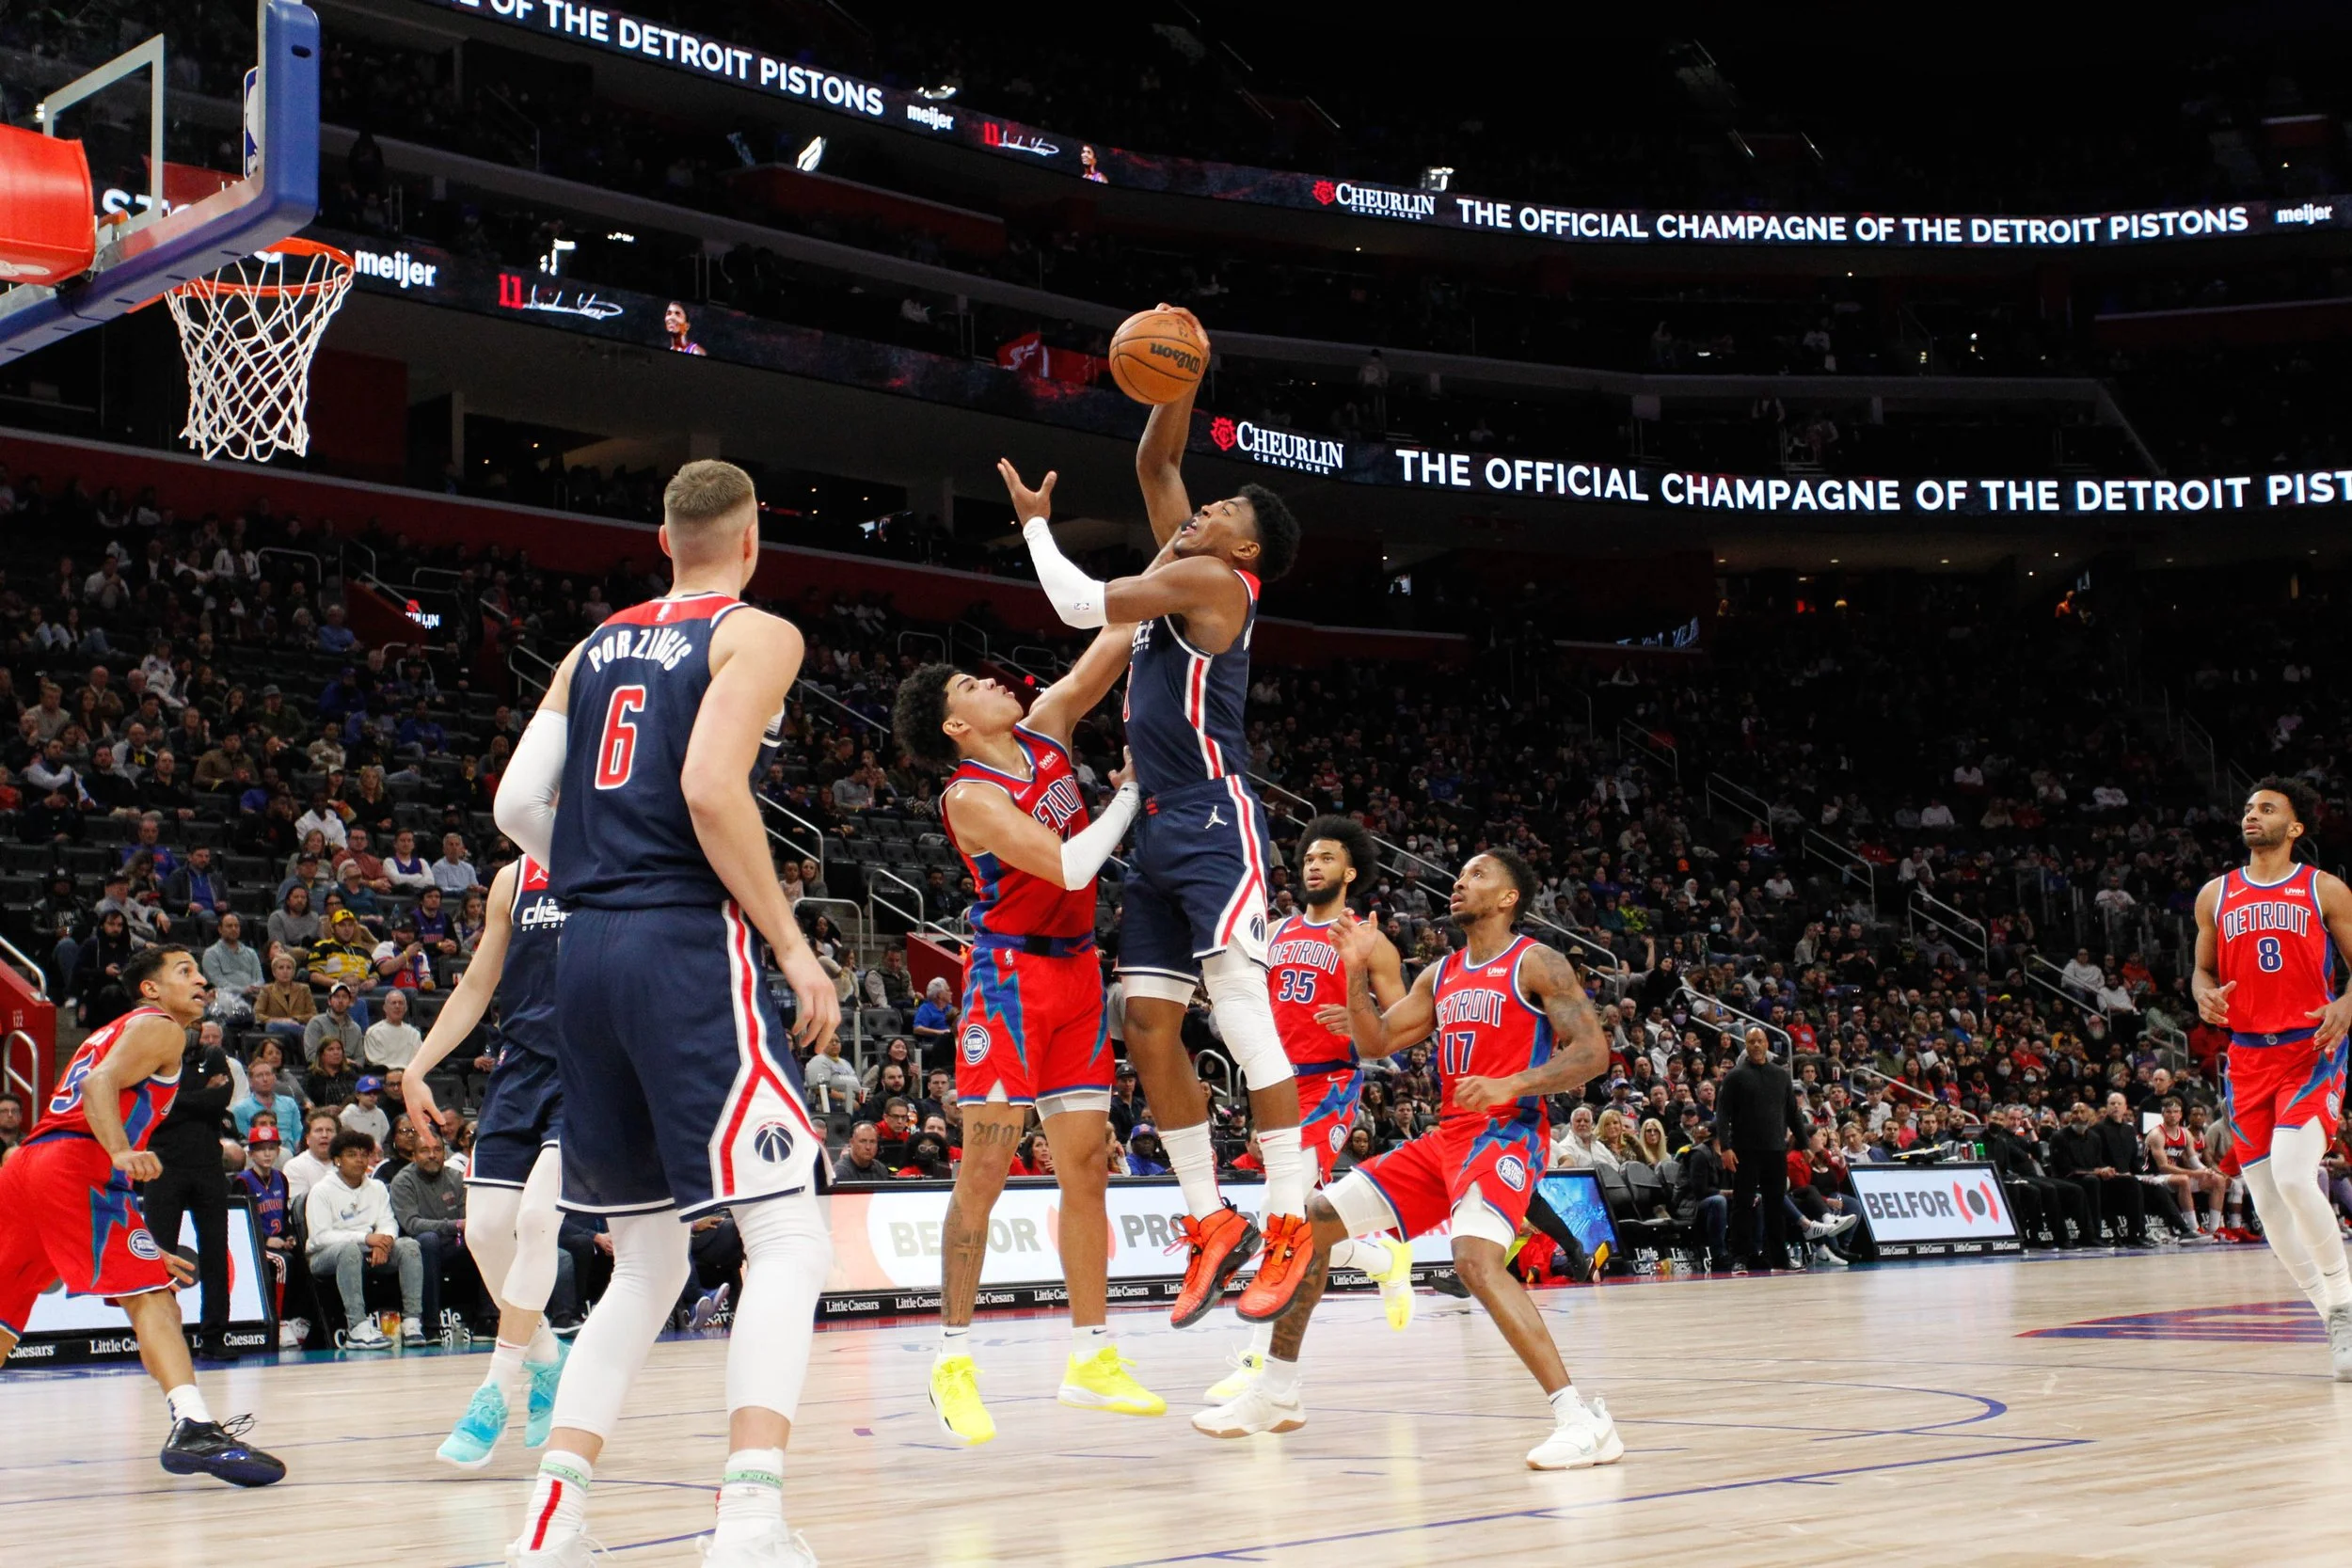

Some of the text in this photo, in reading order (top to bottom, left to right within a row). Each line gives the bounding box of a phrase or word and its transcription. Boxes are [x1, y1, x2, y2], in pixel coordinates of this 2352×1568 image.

[543, 0, 610, 42] THE
[619, 18, 752, 79] DETROIT
[760, 56, 884, 116] PISTONS
[906, 103, 954, 130] meijer
[1335, 182, 1436, 215] CHEURLIN
[2275, 203, 2333, 225] meijer
[1456, 198, 2249, 244] THE OFFICIAL CHAMPAGNE OF THE DETROIT PISTONS
[355, 248, 437, 289] meijer
[499, 273, 524, 309] 11
[1236, 421, 1343, 469] CHEURLIN
[1253, 452, 1329, 475] CHAMPAGNE
[1395, 449, 2352, 511] THE OFFICIAL CHAMPAGNE OF THE DETROIT PIST
[587, 626, 692, 673] PORZINGIS
[594, 684, 646, 790] 6
[2223, 901, 2311, 942] DETROIT
[2258, 936, 2282, 973] 8
[1278, 969, 1317, 1004] 35
[1445, 1031, 1475, 1074] 17
[49, 1048, 92, 1114] 5
[1864, 1190, 1955, 1220] BELFOR
[889, 1217, 1042, 1259] BEOR
[1034, 1290, 1054, 1301] Little
[1121, 1286, 1149, 1296] Caesars
[1333, 1275, 1349, 1285] Little
[826, 1299, 880, 1312] Little Caesars
[896, 1296, 942, 1308] Little Caesar
[985, 1292, 1015, 1304] Caesars
[8, 1344, 55, 1358] Caesars
[90, 1338, 120, 1354] Little
[224, 1332, 266, 1347] Caesars
